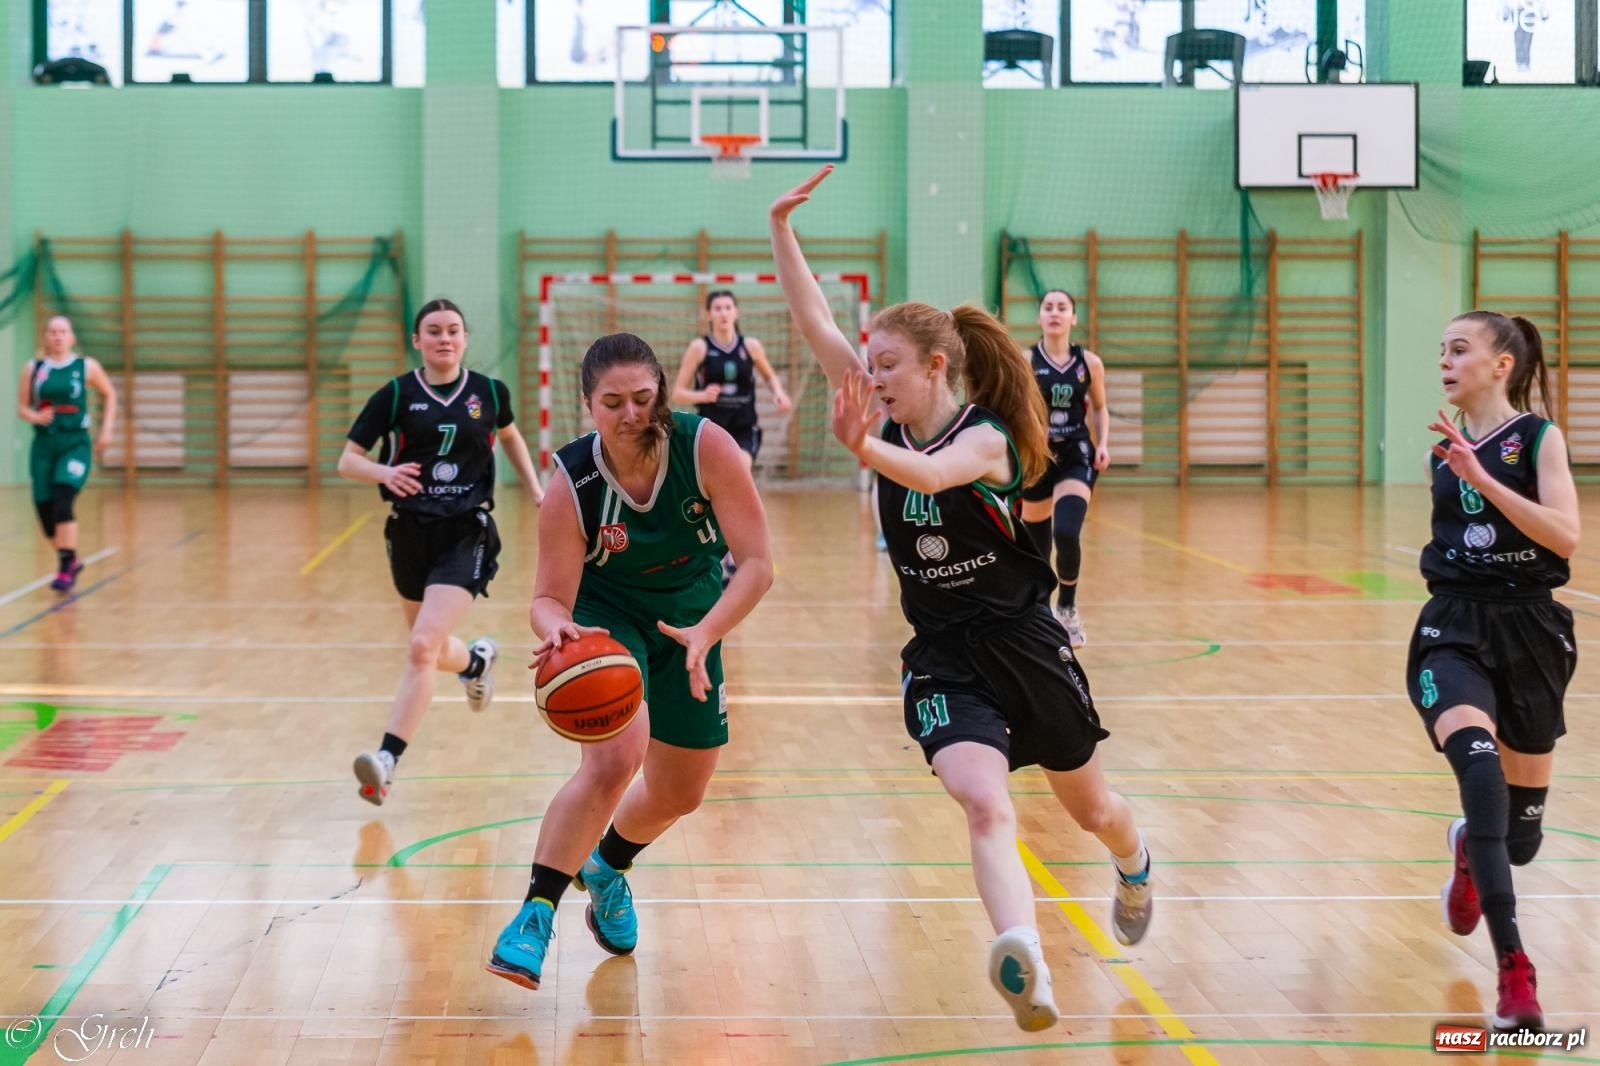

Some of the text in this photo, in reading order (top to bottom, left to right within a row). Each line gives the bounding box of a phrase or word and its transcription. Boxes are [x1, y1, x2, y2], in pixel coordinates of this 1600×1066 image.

[1051, 383, 1073, 408] 12
[437, 424, 457, 456] 7
[575, 470, 599, 489] COLO
[696, 517, 718, 544] 4
[919, 551, 997, 579] LOGISTICS
[574, 701, 634, 730] molten
